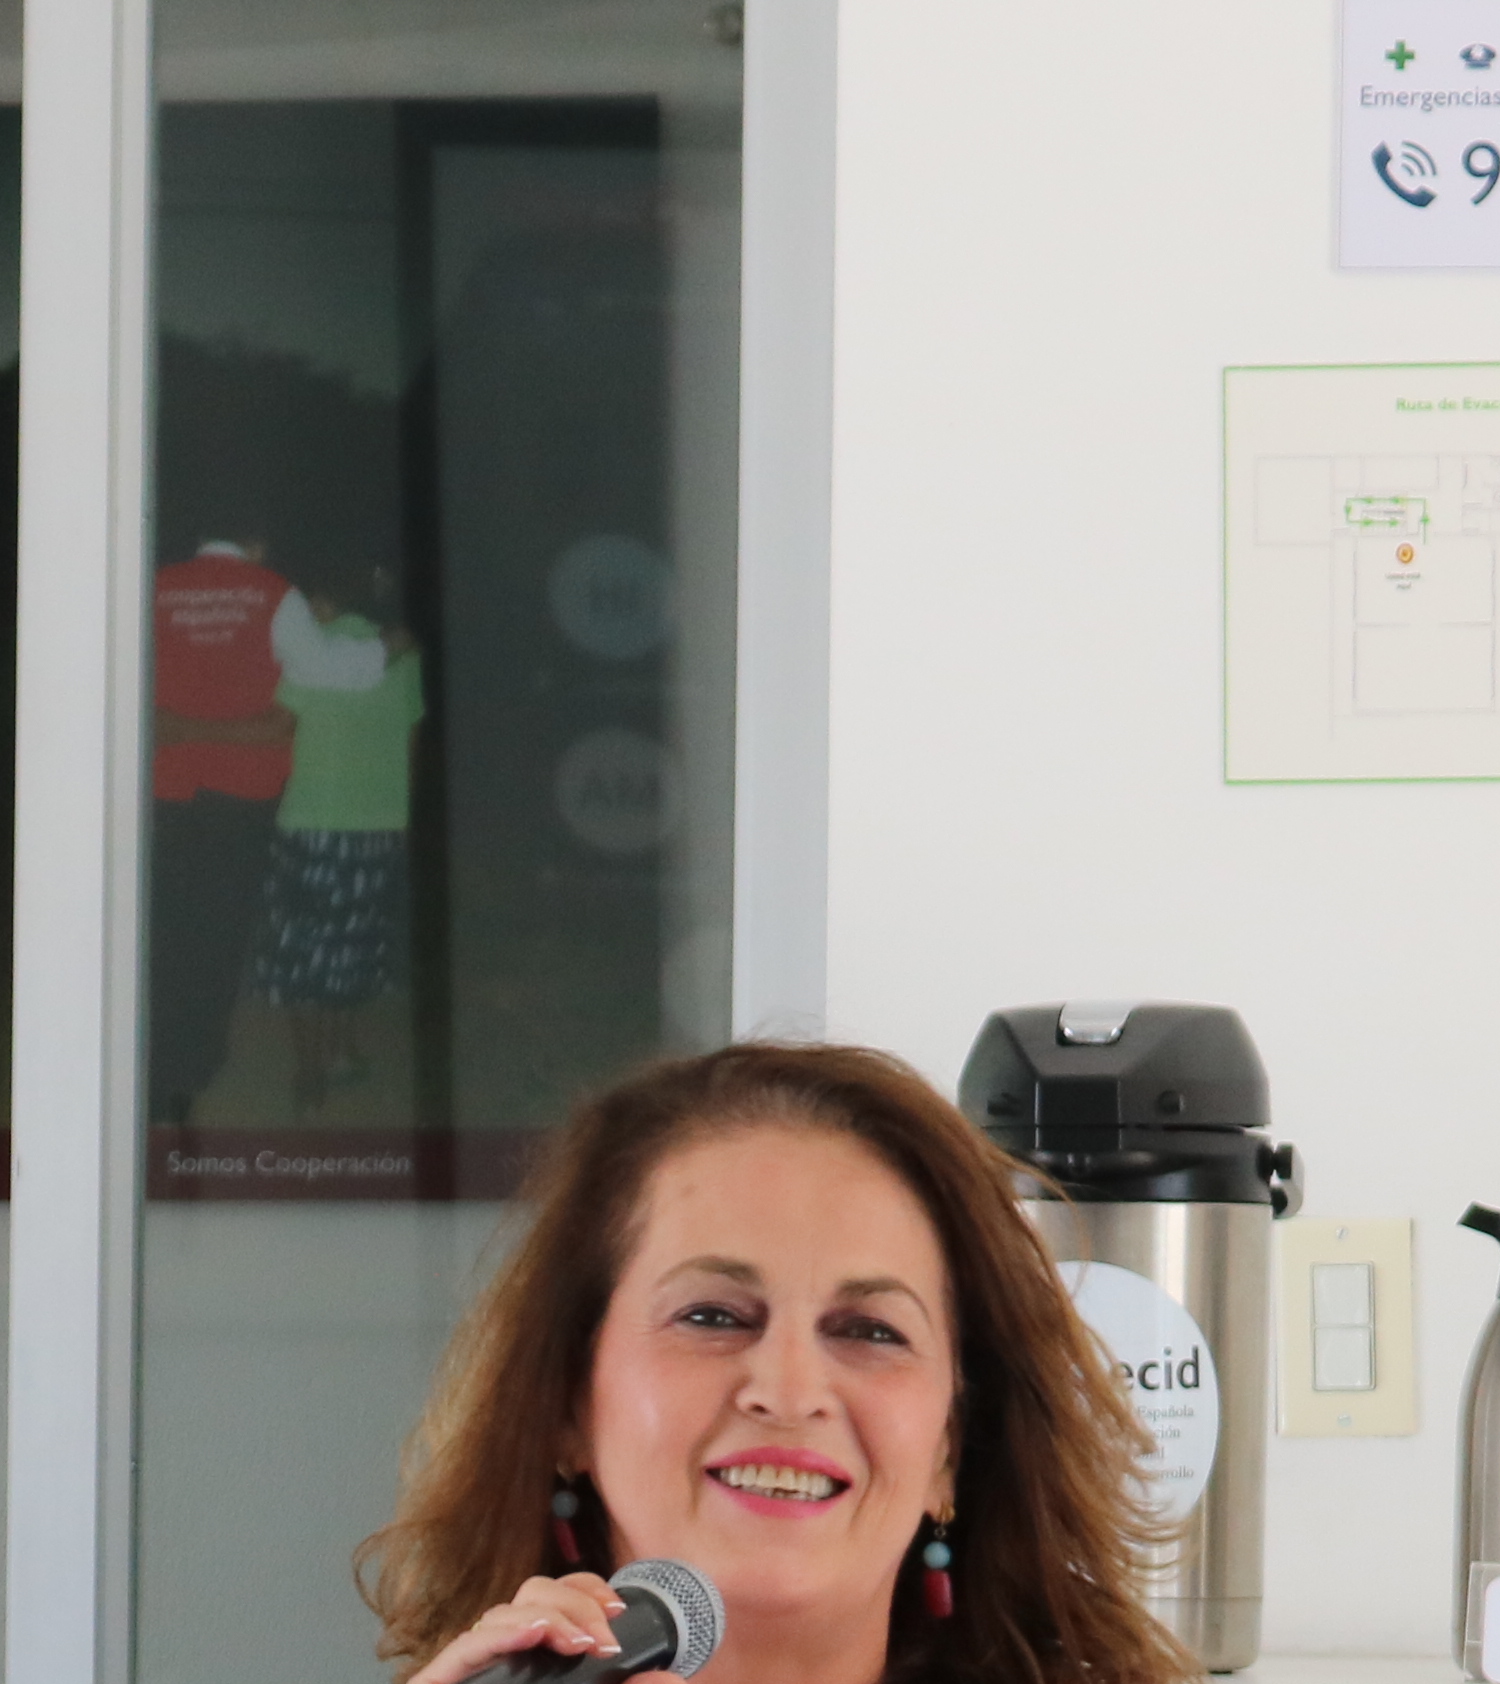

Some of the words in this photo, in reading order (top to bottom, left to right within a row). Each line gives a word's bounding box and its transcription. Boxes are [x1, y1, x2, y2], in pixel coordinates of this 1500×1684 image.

[1438, 398, 1456, 410] de
[167, 1151, 247, 1175] Somos
[255, 1149, 413, 1180] Cooperación
[1119, 1345, 1200, 1391] ecid
